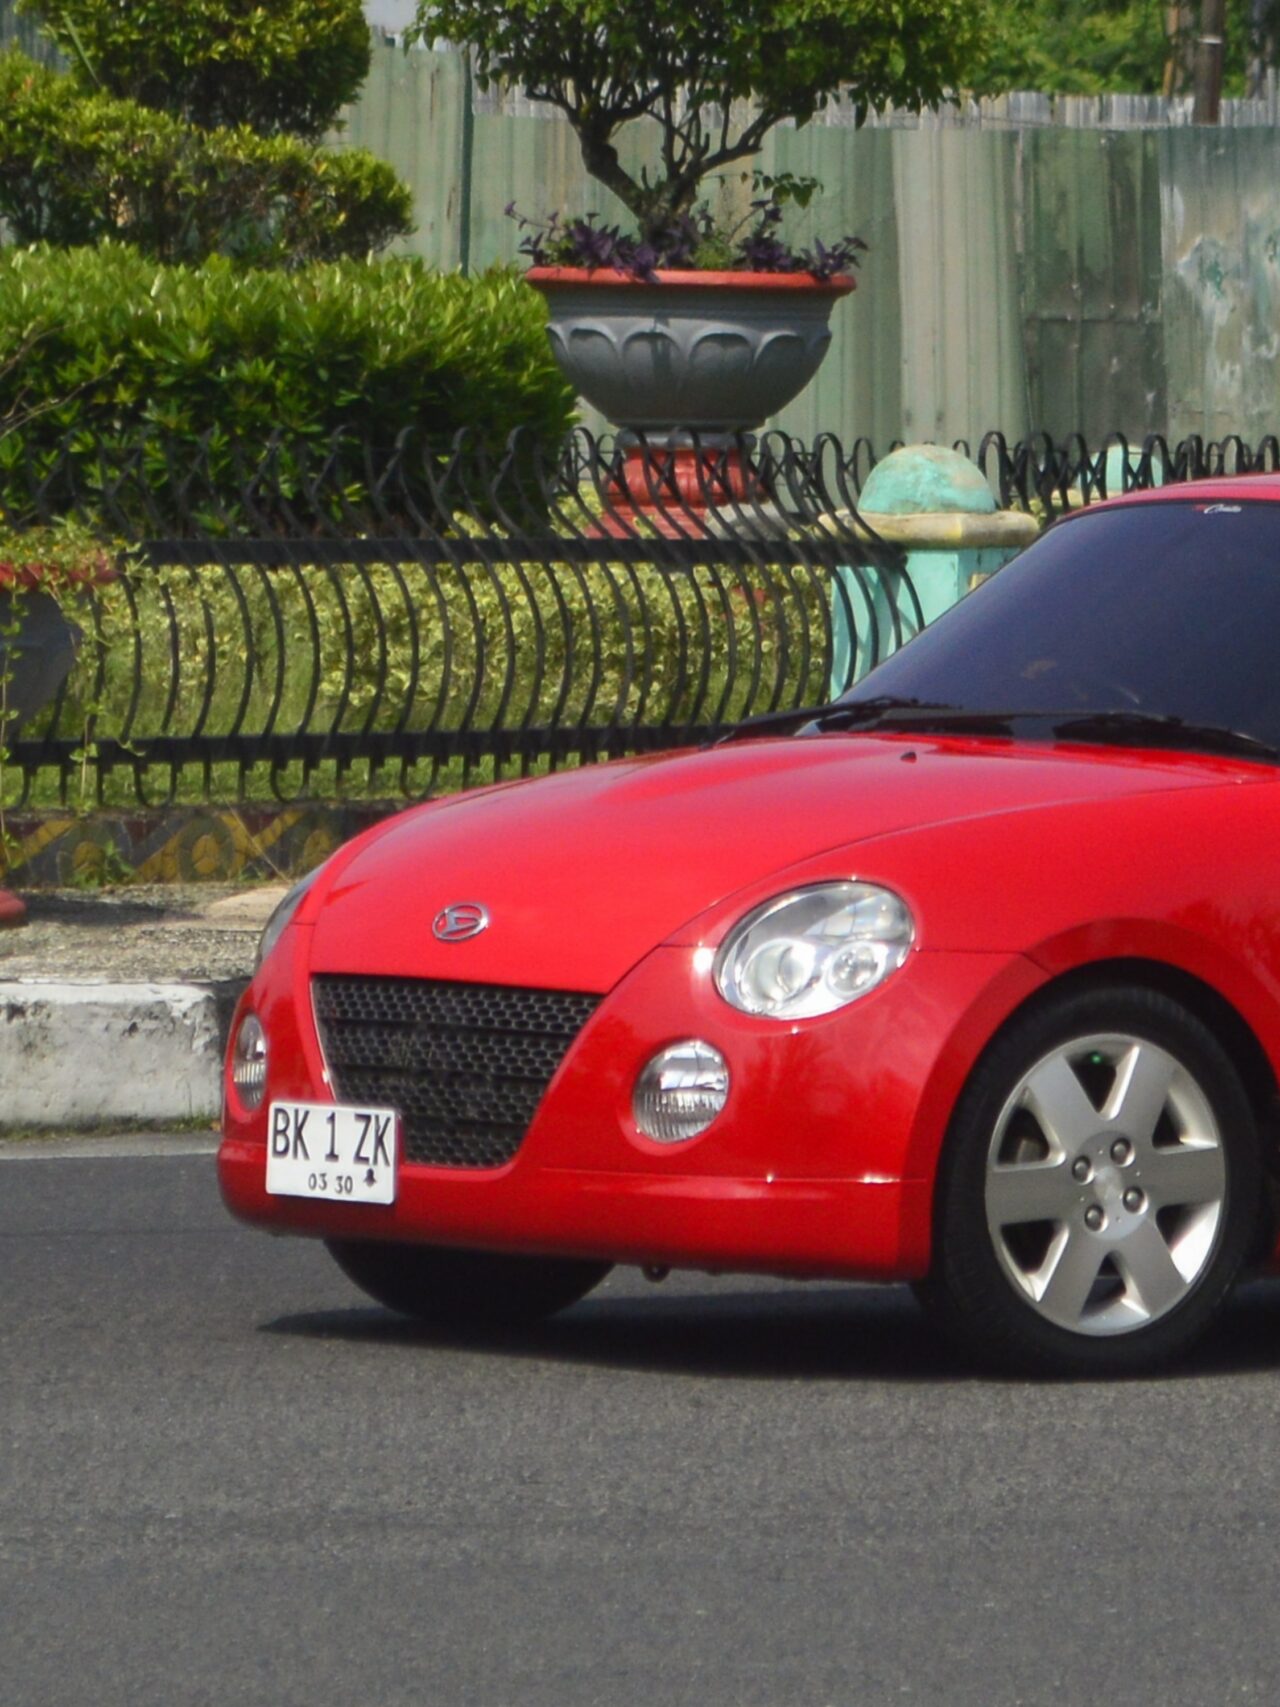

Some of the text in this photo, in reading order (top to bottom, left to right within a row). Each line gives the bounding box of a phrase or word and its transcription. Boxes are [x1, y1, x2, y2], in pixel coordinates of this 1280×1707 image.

[272, 1107, 391, 1166] BK 1 ZK
[308, 1173, 354, 1194] 03 30
